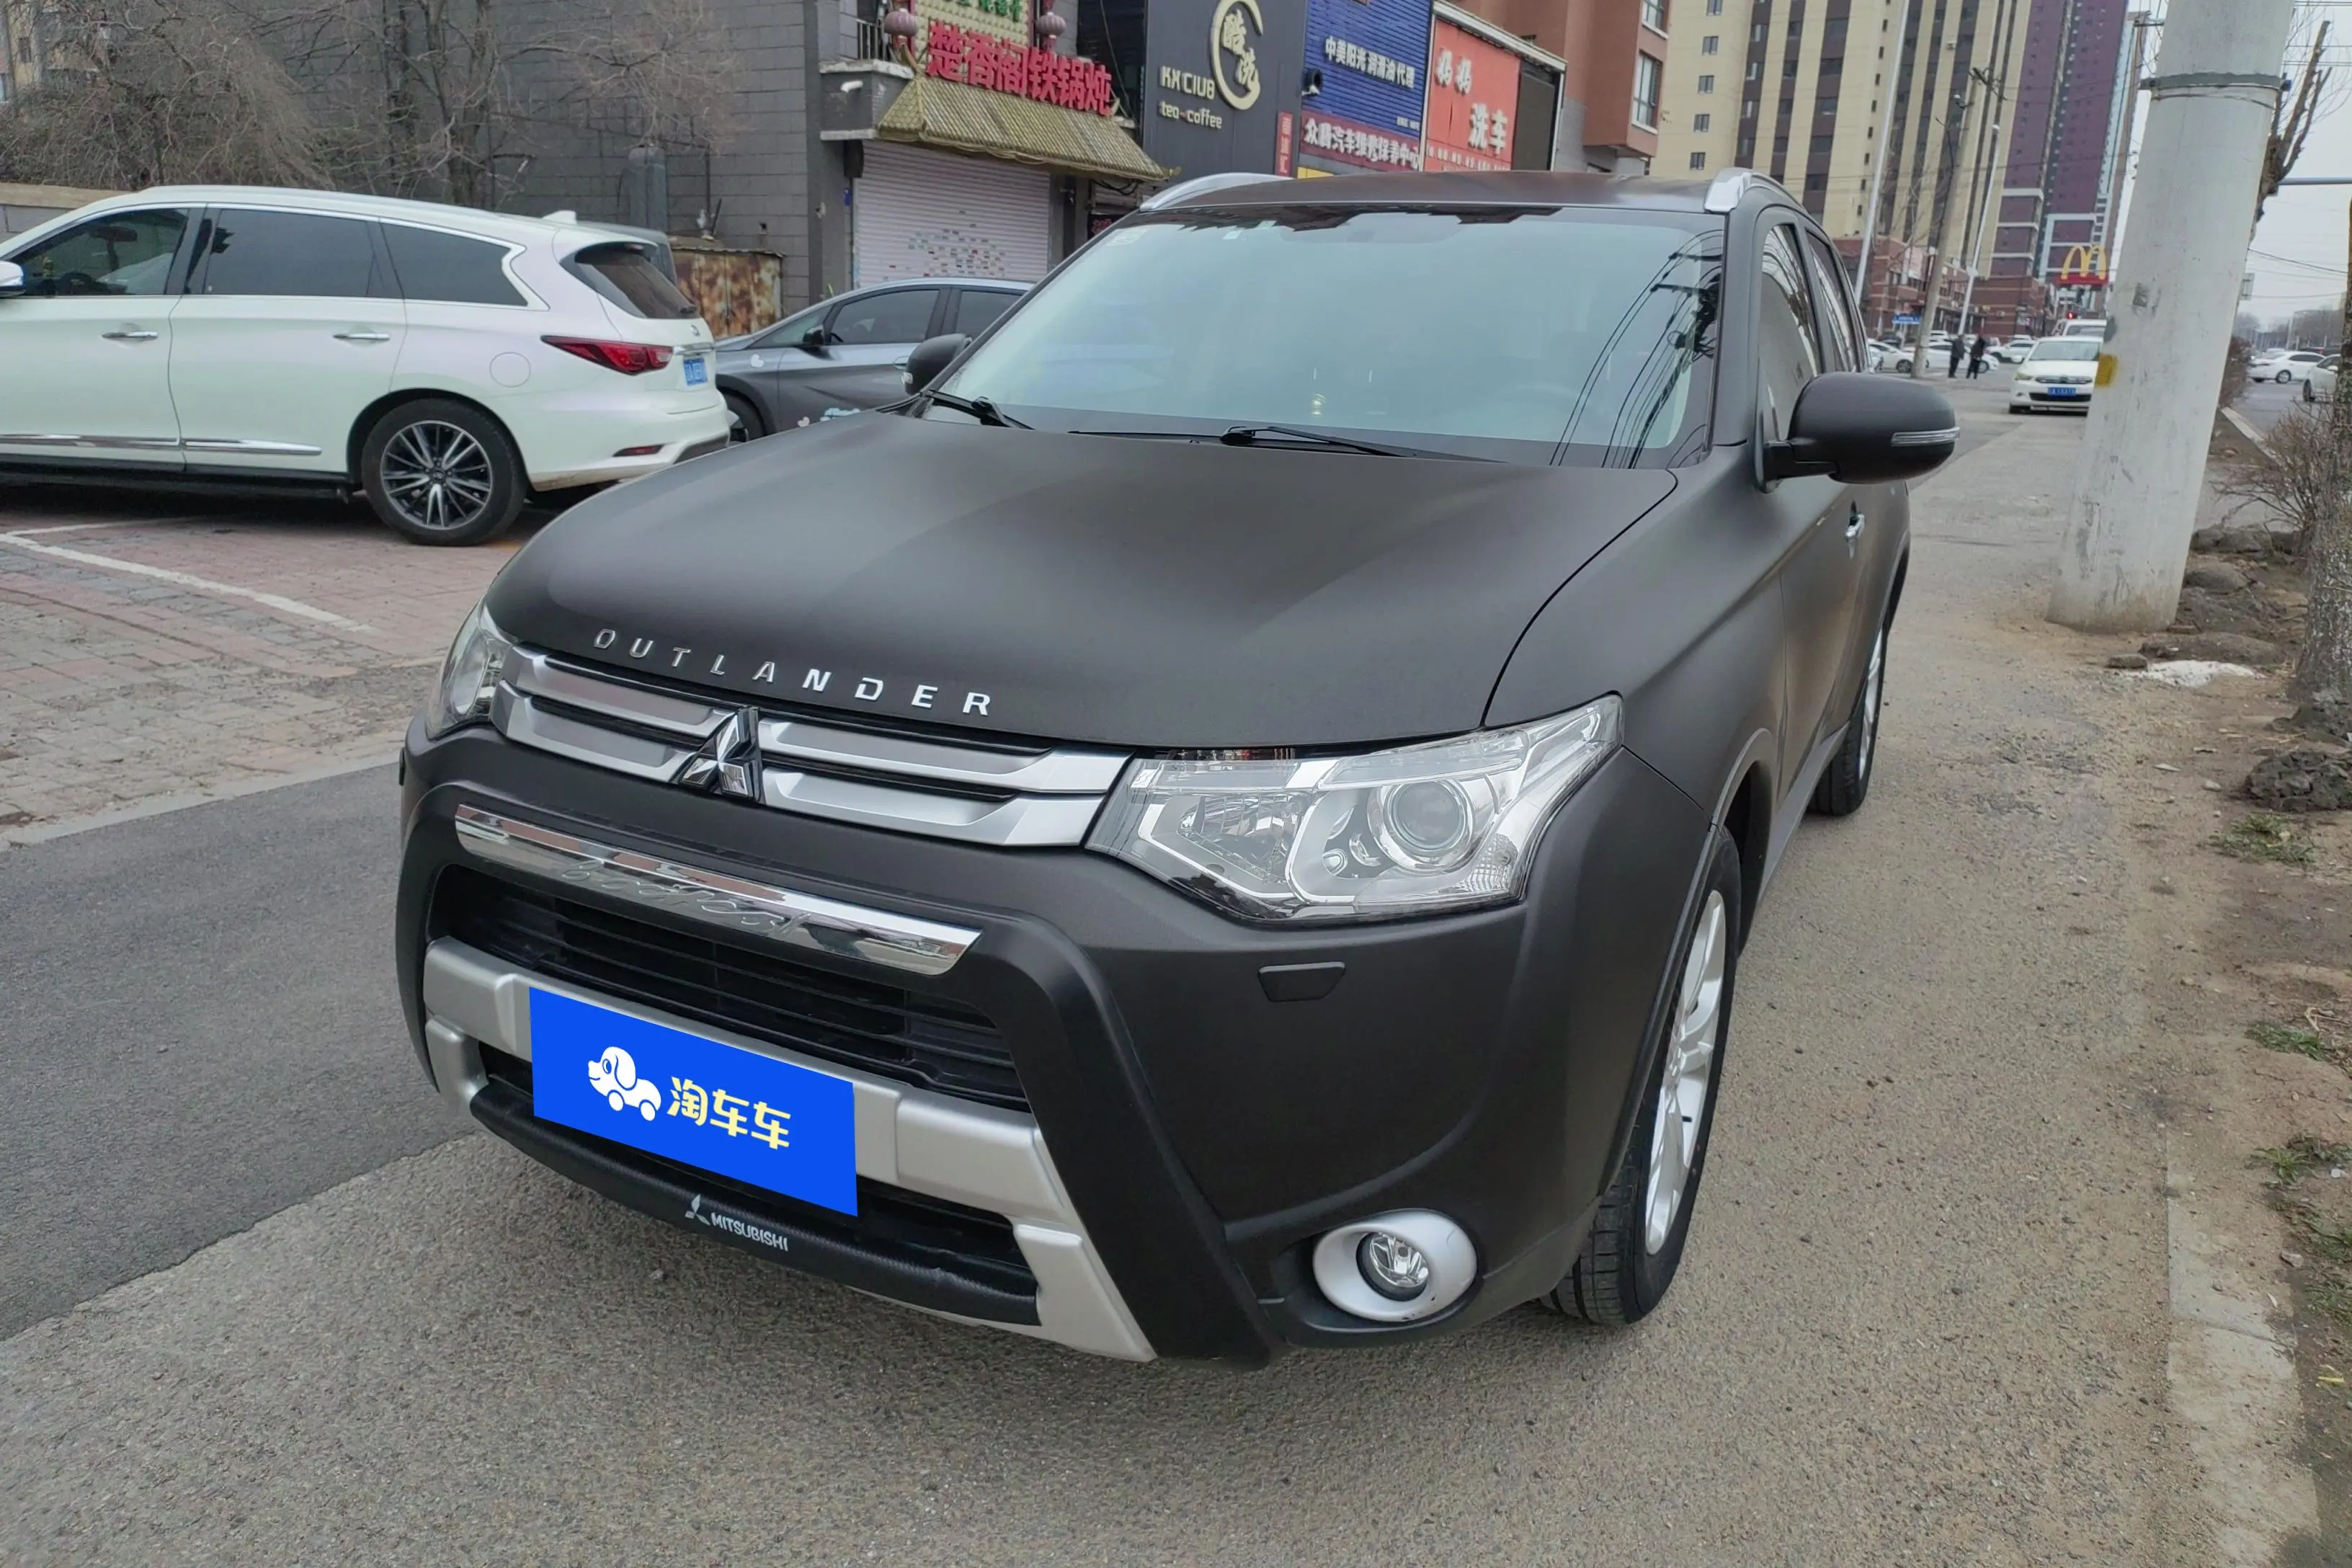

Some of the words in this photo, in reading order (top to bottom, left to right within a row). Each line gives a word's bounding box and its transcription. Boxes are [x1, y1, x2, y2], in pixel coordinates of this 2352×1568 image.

[927, 19, 1112, 117] 楚香阁铁锅炖
[594, 628, 991, 716] OUTLANDER
[710, 1212, 788, 1252] MITSUBISHI
